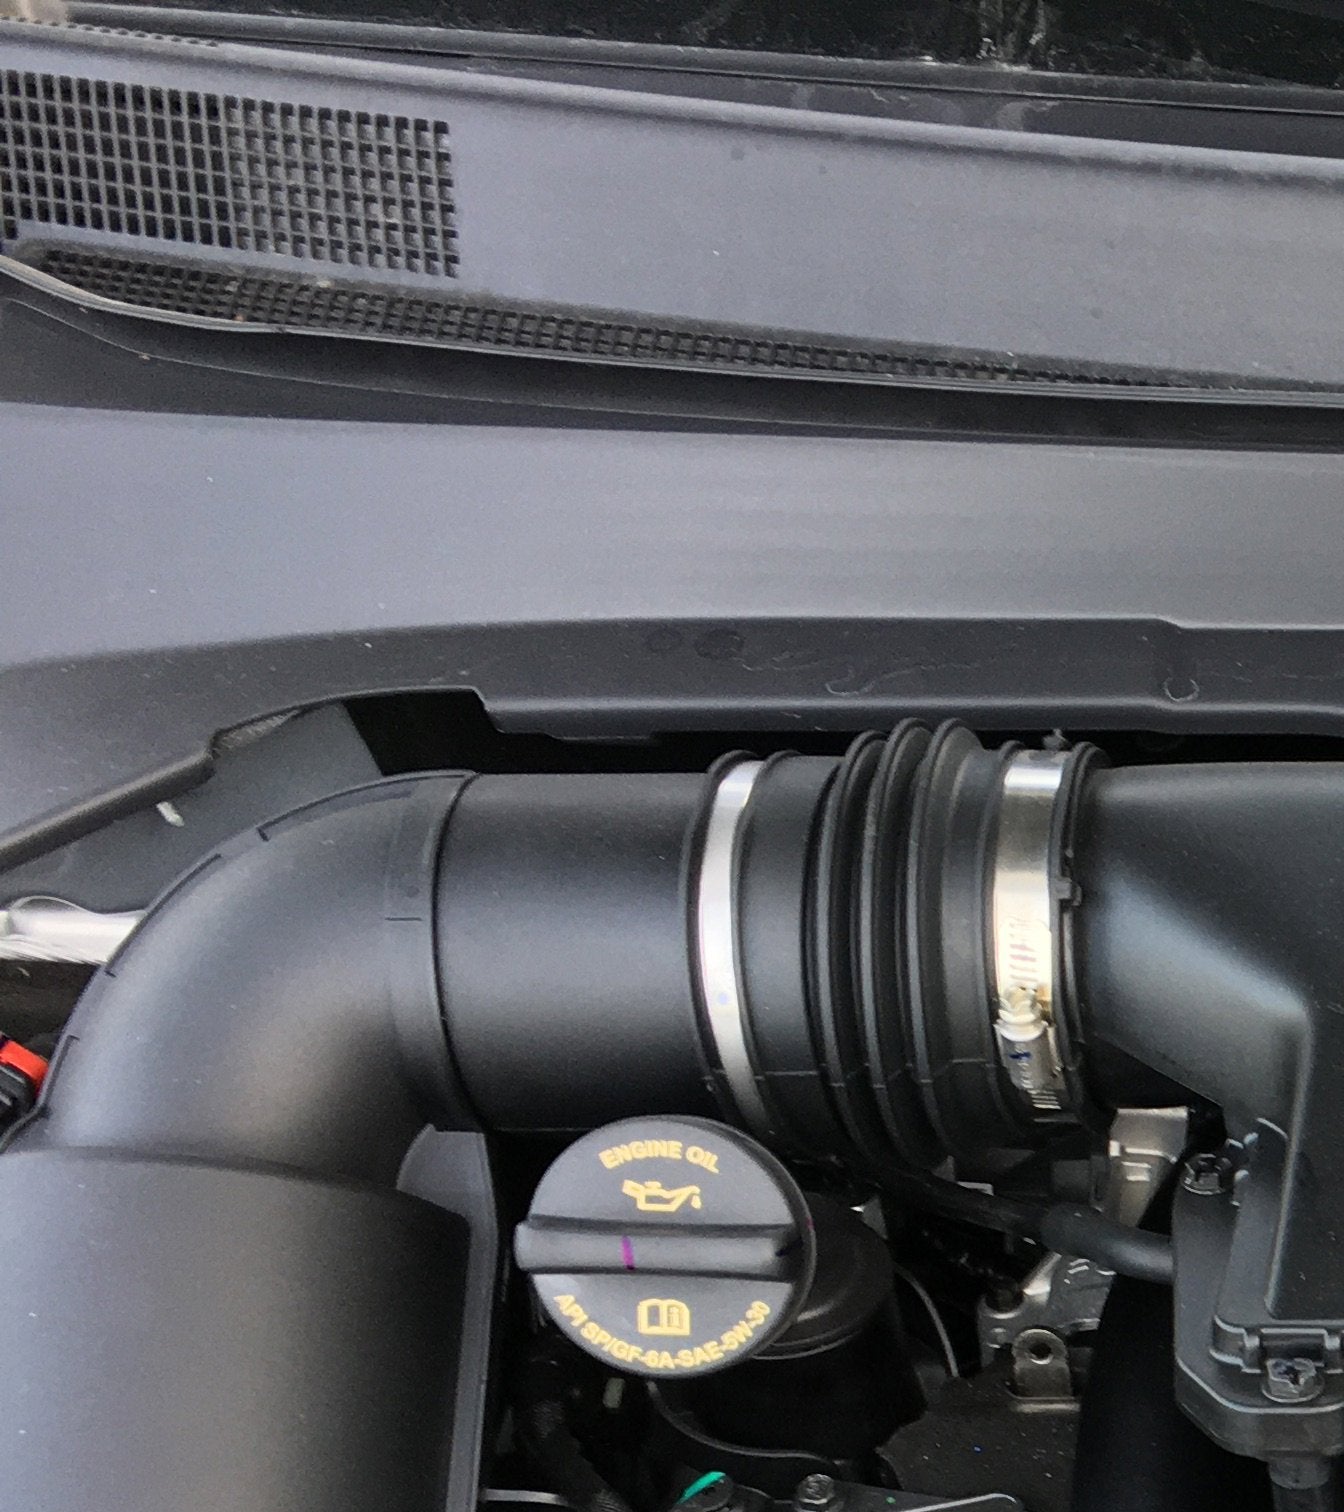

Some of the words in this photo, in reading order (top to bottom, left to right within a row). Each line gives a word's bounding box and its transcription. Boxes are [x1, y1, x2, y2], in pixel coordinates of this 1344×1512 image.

[599, 1140, 682, 1169] ENGINE
[686, 1146, 720, 1174] OIL
[554, 1294, 588, 1327] API
